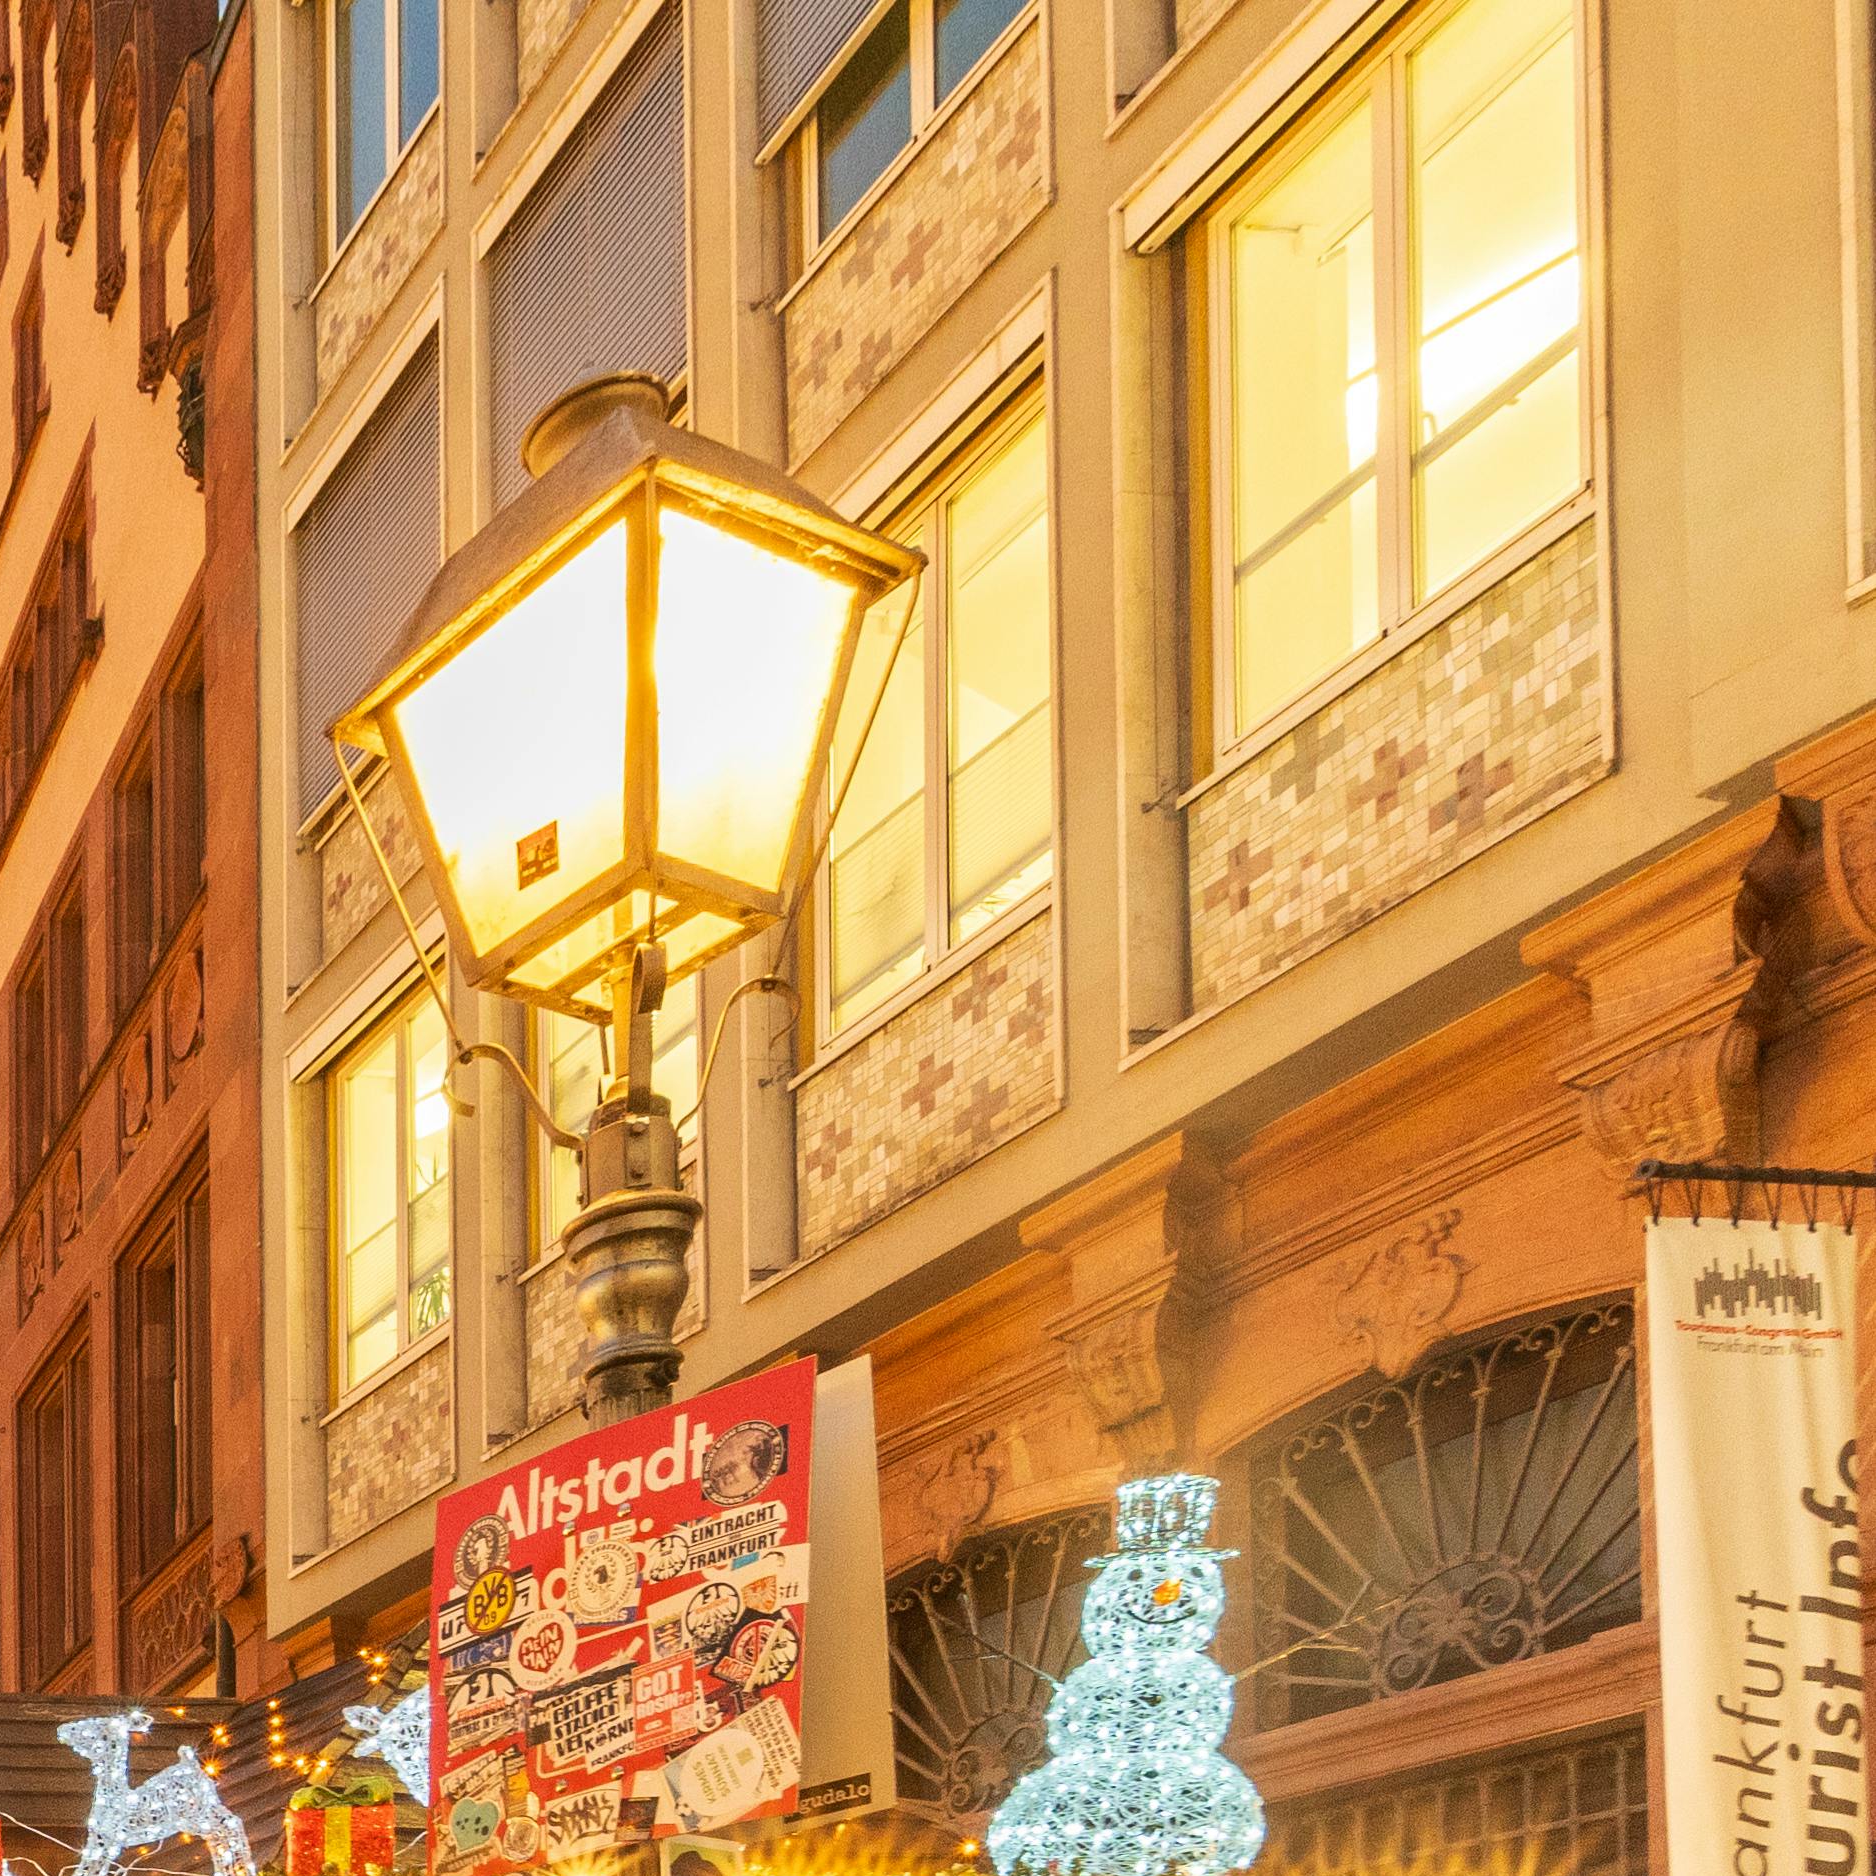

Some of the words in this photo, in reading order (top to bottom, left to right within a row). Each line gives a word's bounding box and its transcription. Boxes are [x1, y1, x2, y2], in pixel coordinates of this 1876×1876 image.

[496, 1413, 714, 1540] Altstadt
[691, 1503, 777, 1544] EINTRACHT
[689, 1531, 778, 1571] FRANKFURT
[473, 1576, 509, 1618] BVB
[521, 1624, 559, 1654] MEIN
[635, 1664, 684, 1703] GOT
[799, 1783, 870, 1815] gudalo
